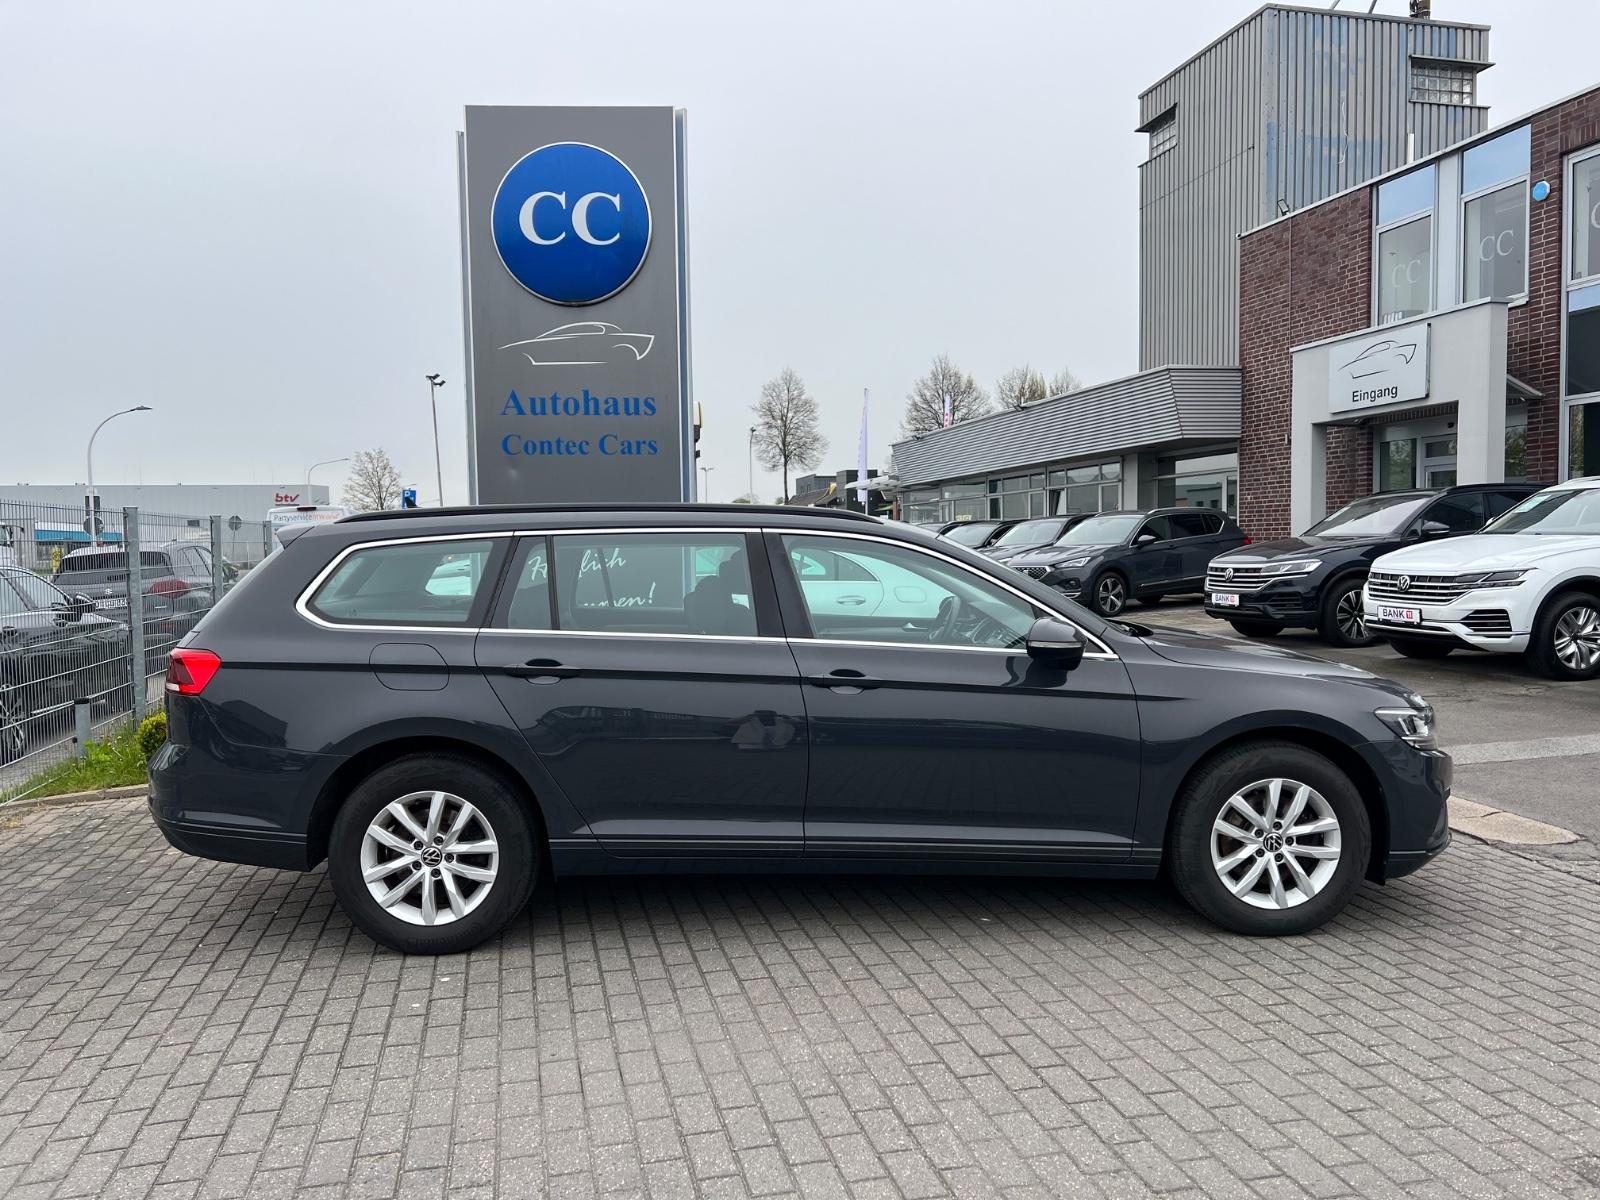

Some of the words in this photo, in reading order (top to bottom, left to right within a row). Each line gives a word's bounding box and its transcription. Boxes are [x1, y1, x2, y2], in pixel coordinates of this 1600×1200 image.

[519, 191, 620, 245] CC
[1480, 229, 1514, 262] CC
[1391, 258, 1421, 288] CC
[500, 389, 657, 416] Autohaus
[1352, 386, 1398, 402] Eingang
[502, 434, 590, 456] Contec
[598, 434, 658, 456] Cars
[275, 493, 300, 502] btv
[1383, 609, 1405, 619] BANK
